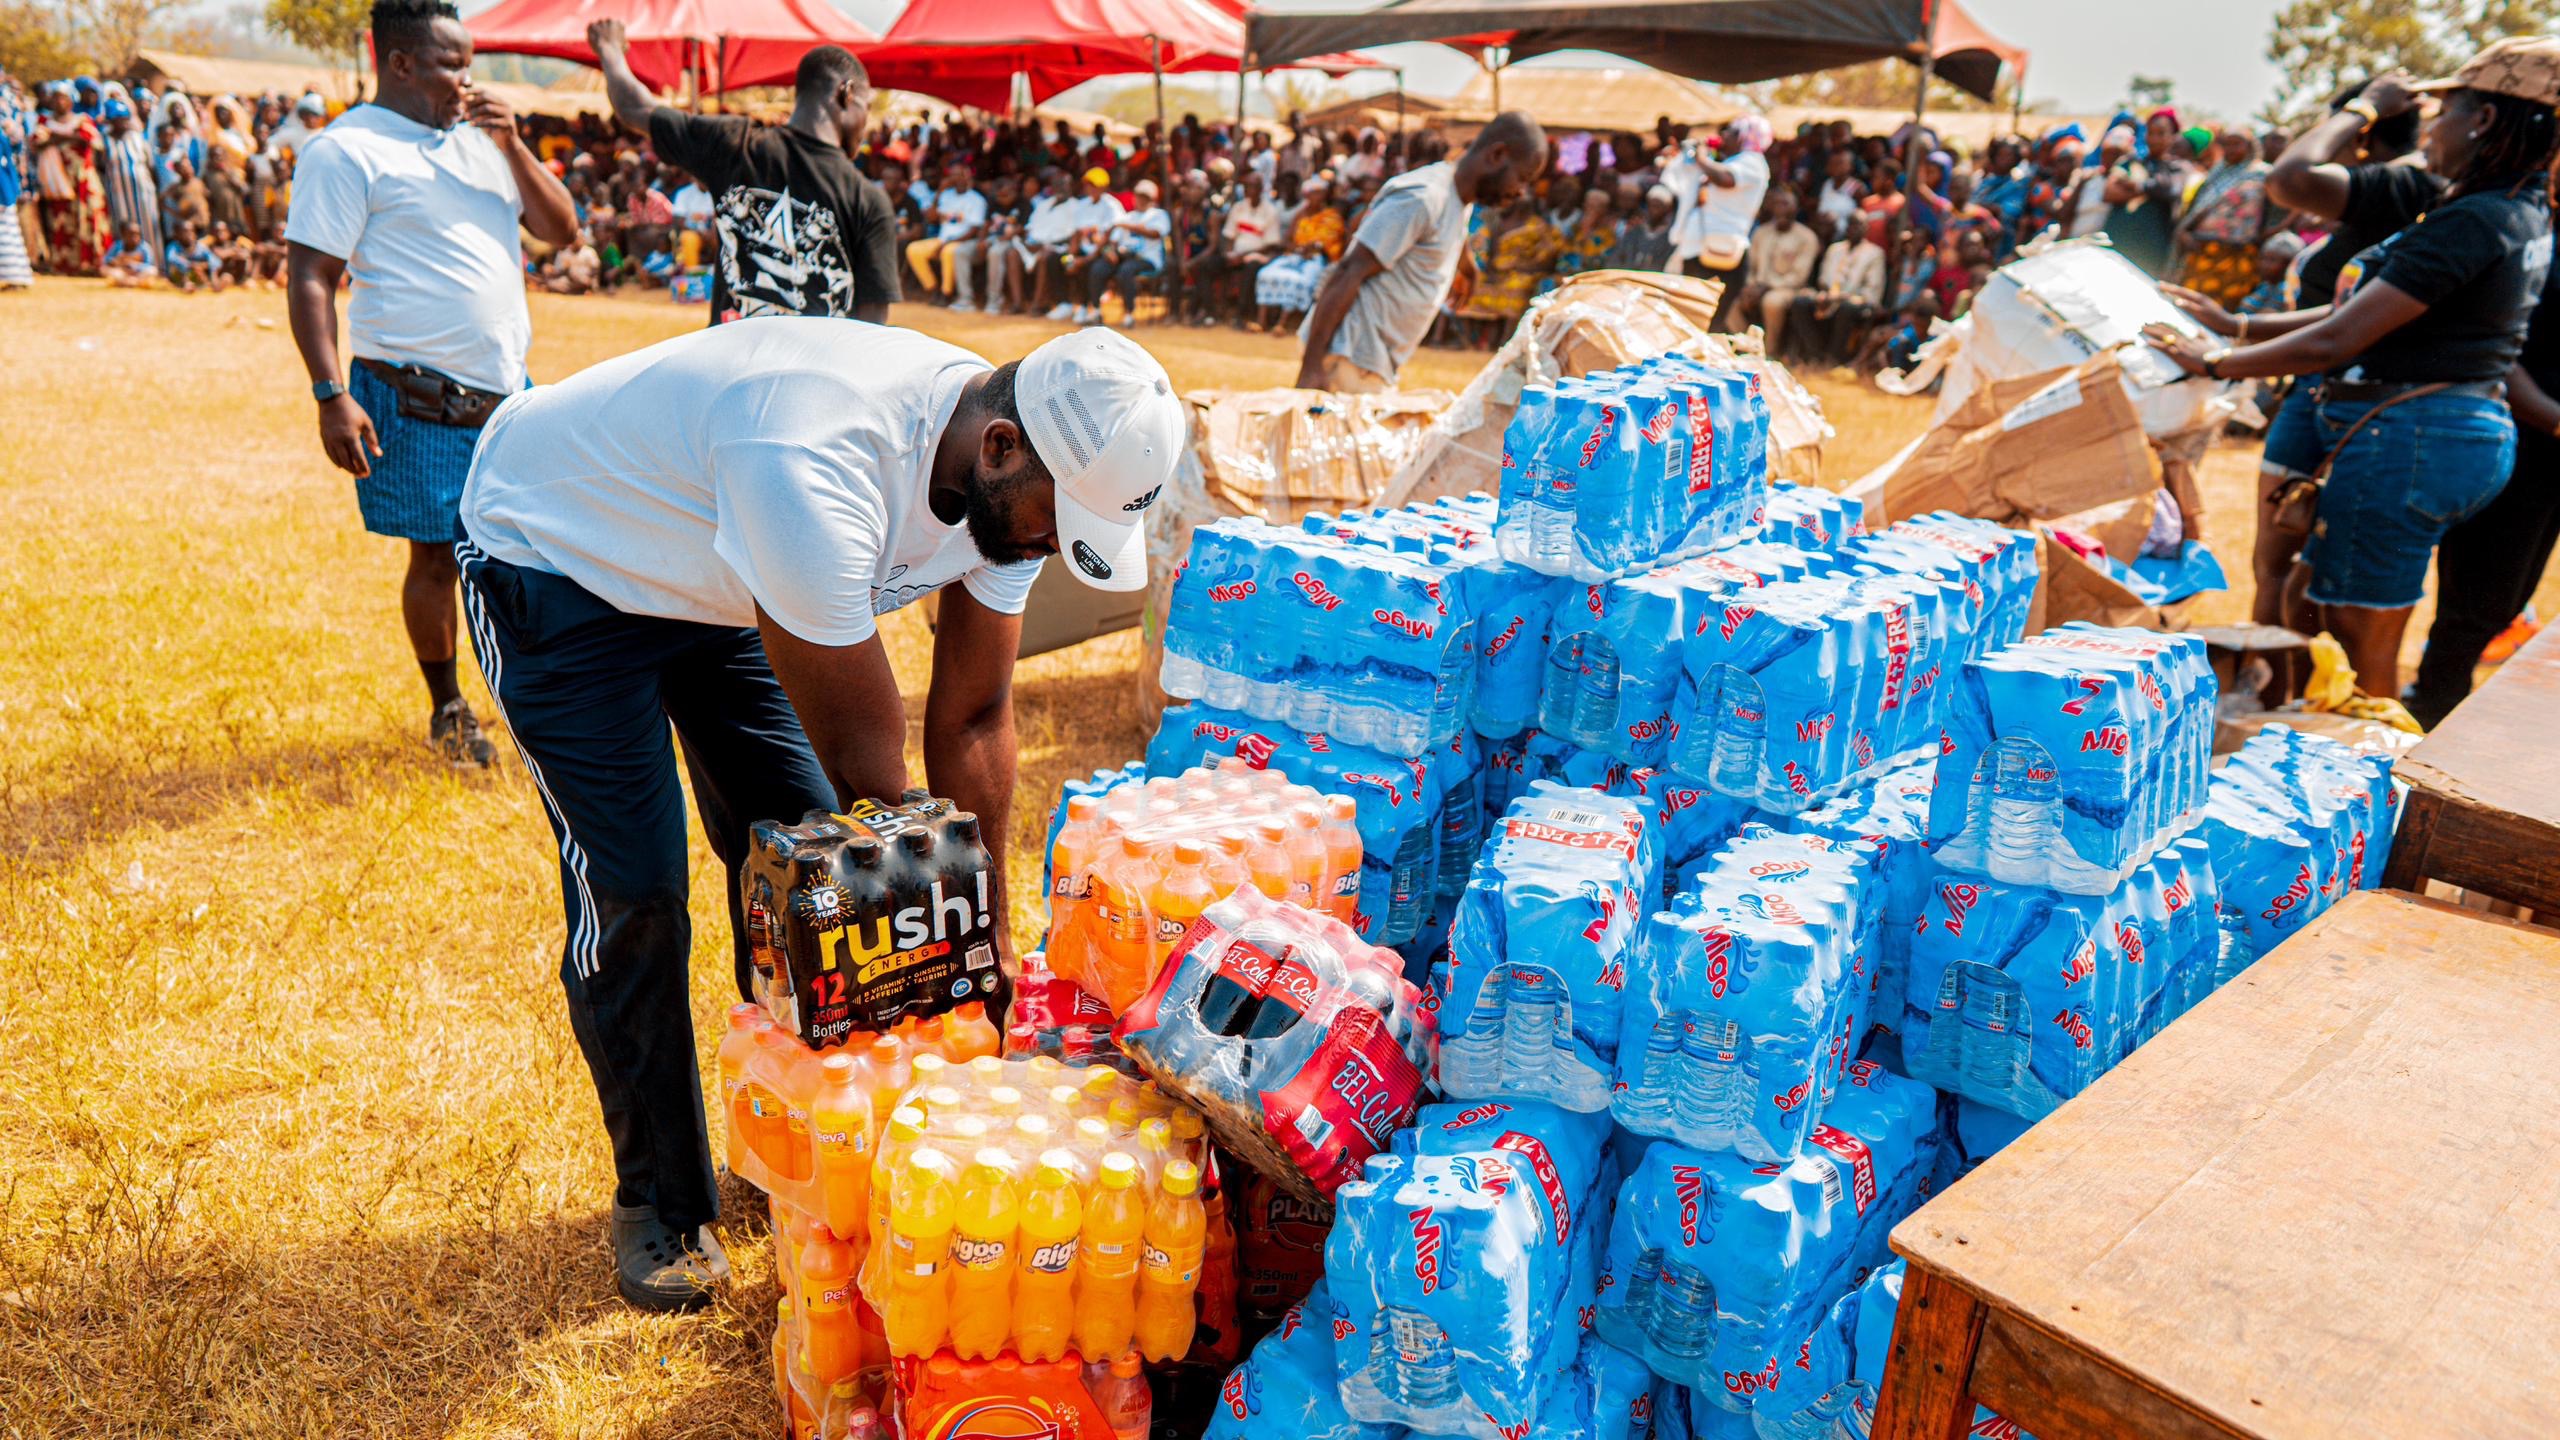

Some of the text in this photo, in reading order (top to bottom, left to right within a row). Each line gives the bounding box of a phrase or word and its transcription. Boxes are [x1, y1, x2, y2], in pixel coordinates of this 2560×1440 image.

[1578, 403, 1615, 467] Migo
[1640, 402, 1679, 444] Migo
[1690, 448, 1712, 493] FREE
[1080, 544, 1101, 565] STRETCH
[1207, 579, 1257, 603] Migo
[1293, 571, 1344, 612] Migo
[1374, 609, 1434, 640] Migo
[1484, 615, 1525, 657] Migo
[1720, 604, 1756, 642] Mig
[2137, 671, 2164, 710] Mig
[1629, 710, 1669, 741] Migo
[1796, 712, 1835, 743] Migo
[2080, 726, 2129, 756] Mig
[1056, 874, 1092, 896] Big
[1333, 869, 1361, 895] Big
[2262, 864, 2311, 920] Migo
[812, 890, 839, 911] 10
[816, 907, 841, 919] YEARS
[1764, 893, 1807, 926] Migo
[818, 871, 991, 971] rush!
[869, 943, 945, 977] ENERGY
[1511, 968, 1545, 984] Migo
[1698, 924, 1733, 999] Migo
[811, 971, 847, 1007] 12
[864, 970, 948, 1003] CAFFEINE TAURINE
[872, 977, 906, 995] VITAMINS
[913, 963, 948, 978] GINSENG
[812, 1018, 852, 1038] Bottles
[1849, 1059, 1881, 1088] igo
[1332, 1060, 1403, 1142] BEL-Cola
[1442, 1102, 1514, 1131] Migo
[816, 1131, 847, 1143] eeva
[1855, 1154, 1874, 1213] FREE
[1270, 1198, 1334, 1223] PLAN
[1673, 1164, 1702, 1248] Migo
[948, 1232, 1005, 1262] igoo
[1031, 1235, 1081, 1268] Bigo
[1409, 1206, 1440, 1296] Migo
[1723, 1356, 1780, 1395] Migo
